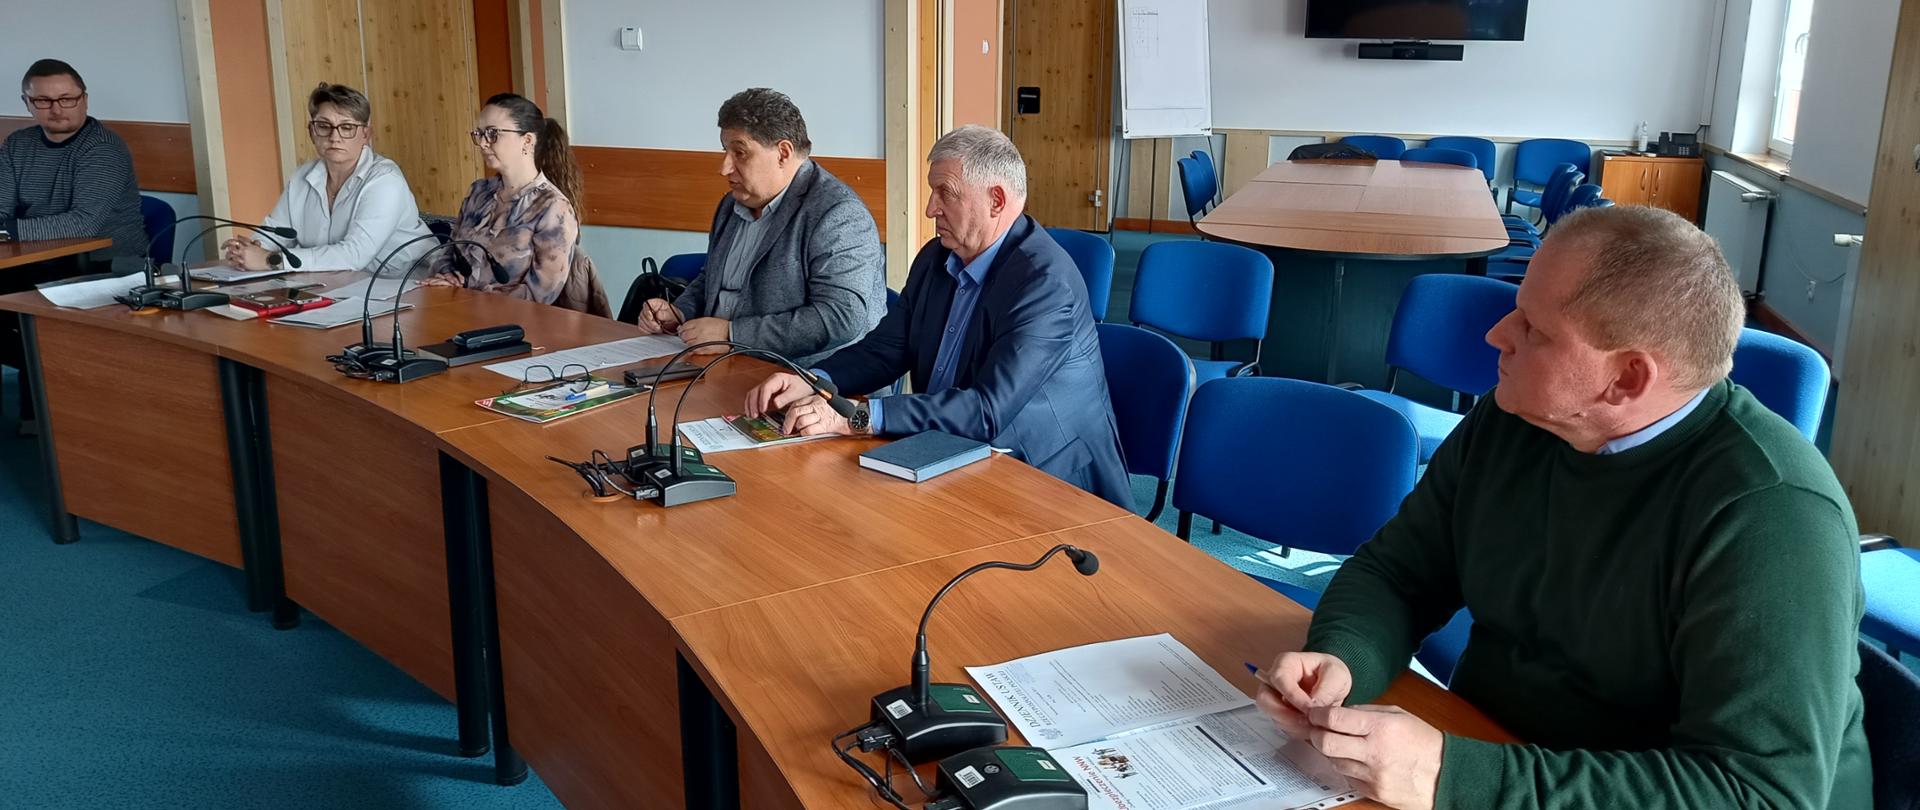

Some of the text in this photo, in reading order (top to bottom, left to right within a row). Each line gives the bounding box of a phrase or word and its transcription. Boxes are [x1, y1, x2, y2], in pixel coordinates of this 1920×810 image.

[985, 672, 1010, 694] USTAW
[1007, 694, 1040, 728] DZIENNIK
[1073, 756, 1092, 771] NNW
